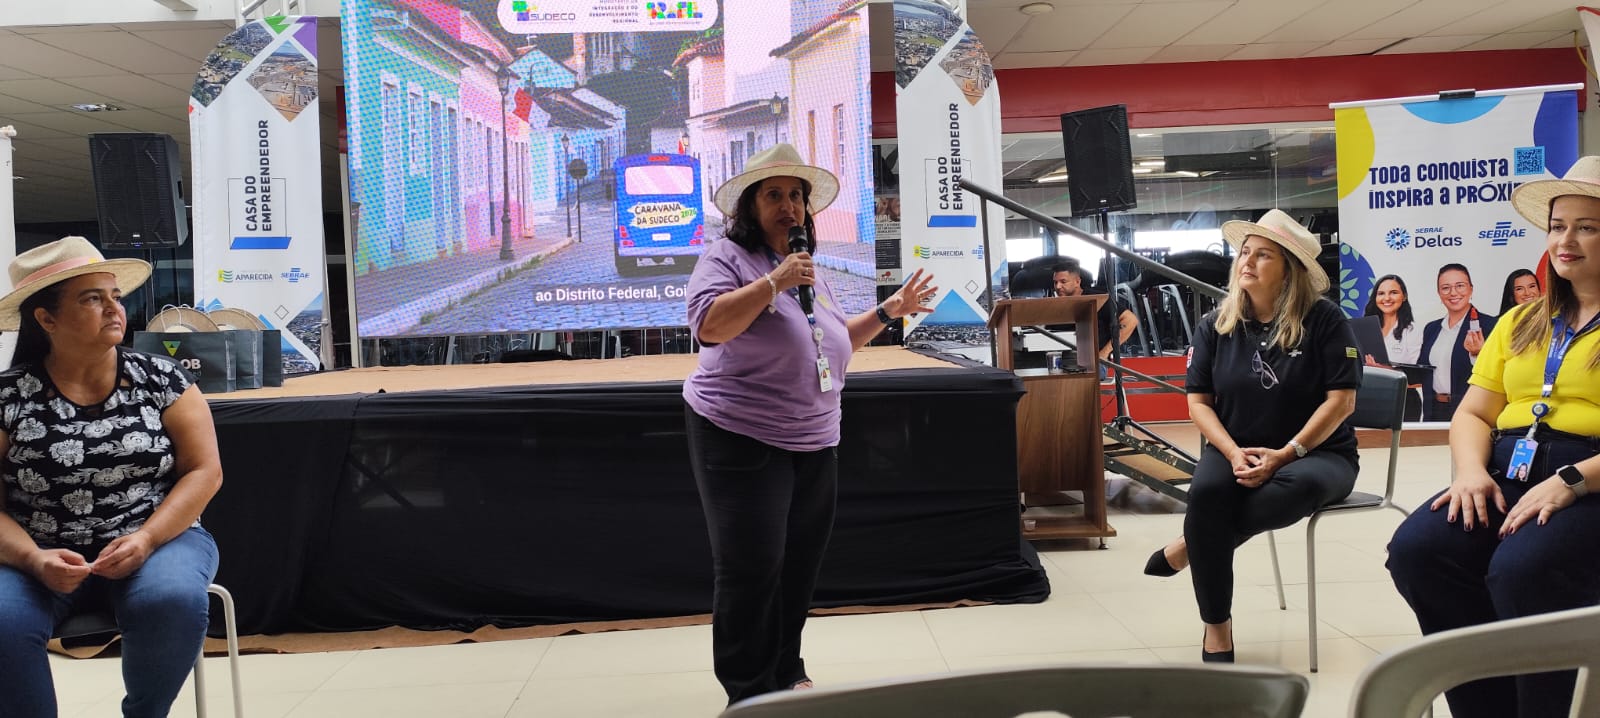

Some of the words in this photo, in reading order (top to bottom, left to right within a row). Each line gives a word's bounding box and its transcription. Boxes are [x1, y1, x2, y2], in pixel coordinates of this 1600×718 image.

[530, 12, 576, 21] SUDECO
[937, 156, 948, 174] DO
[258, 120, 272, 231] EMPREENDEDOR
[244, 175, 257, 194] DO
[939, 178, 949, 210] CASA
[246, 198, 258, 231] CASA
[634, 203, 682, 215] CARAVANA
[637, 217, 648, 225] DA
[649, 215, 680, 224] SUDECO
[1478, 228, 1526, 239] SEBRAE
[1415, 235, 1463, 248] Delas
[235, 273, 274, 281] APARECIDA
[280, 271, 310, 279] SEBRAE
[535, 291, 552, 302] ao
[556, 288, 605, 301] Distrito
[609, 285, 661, 301] Federal,
[664, 285, 687, 298] Goi
